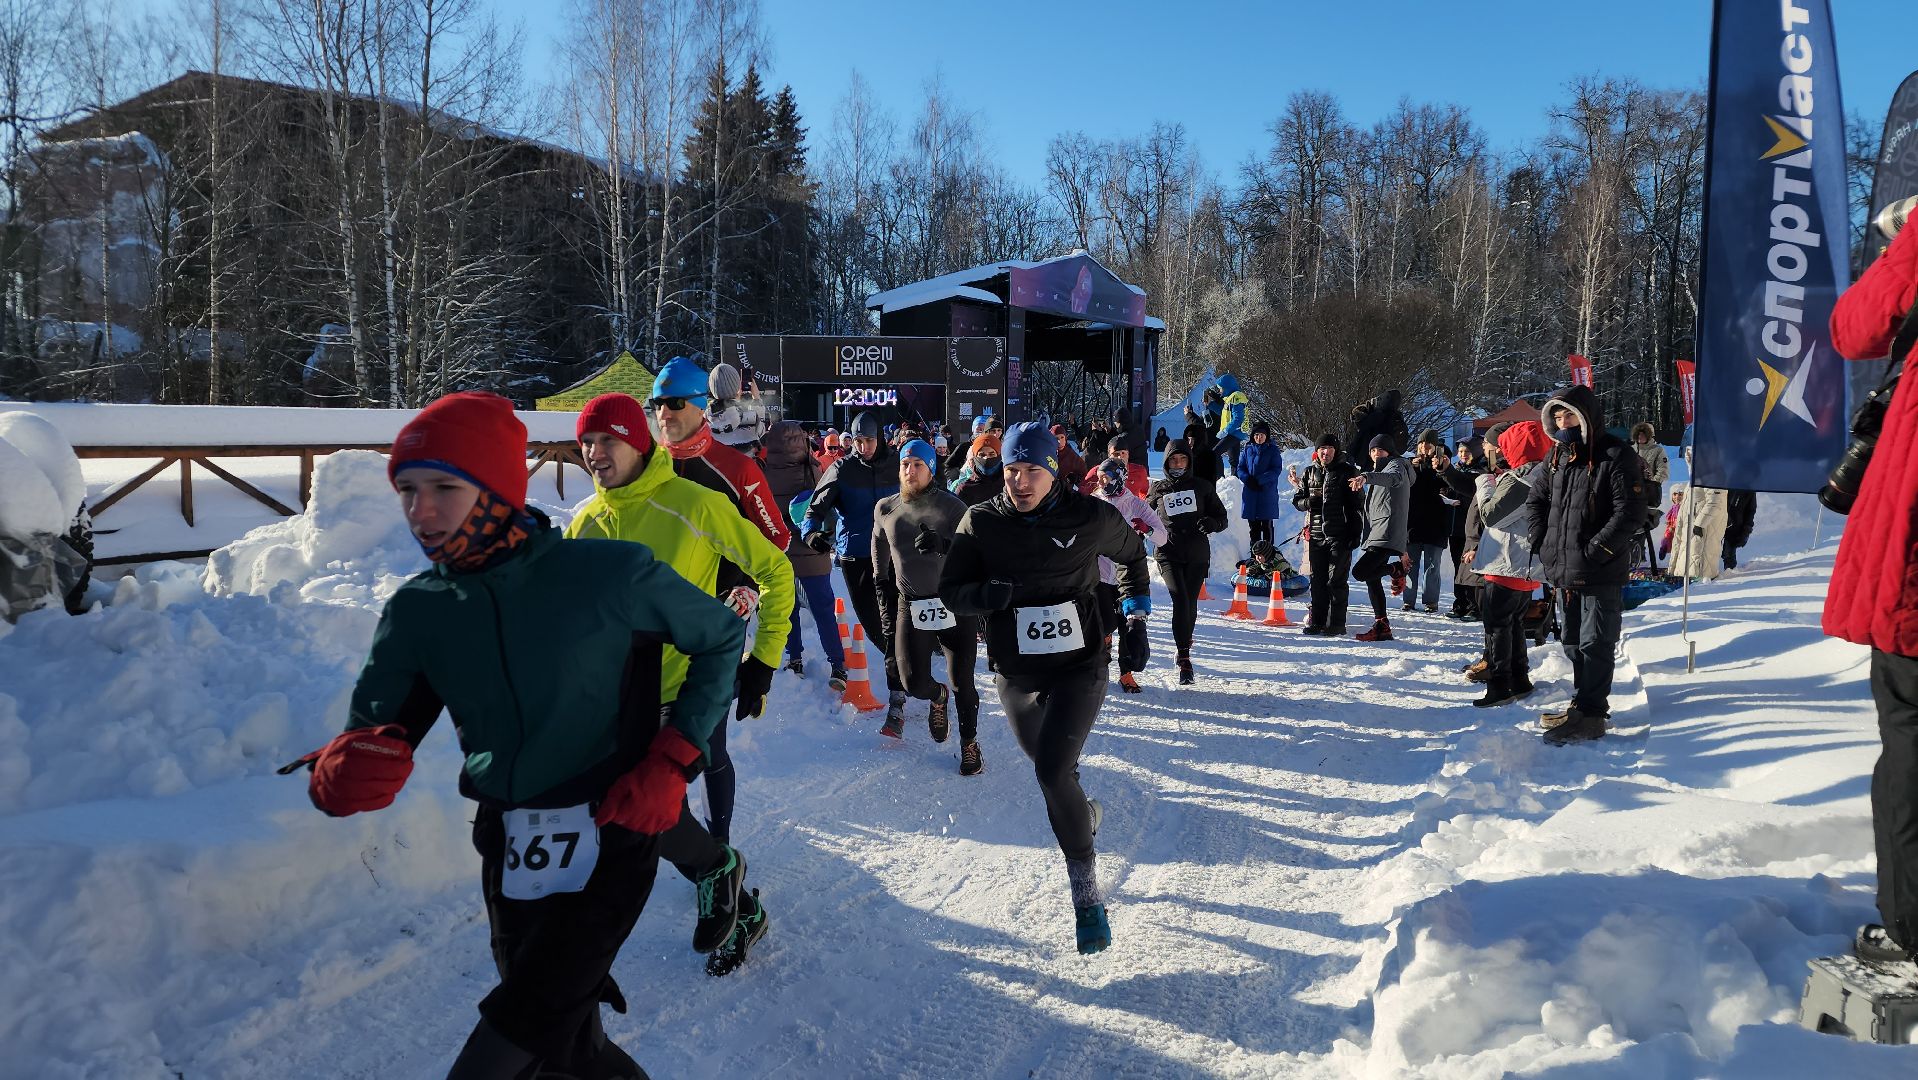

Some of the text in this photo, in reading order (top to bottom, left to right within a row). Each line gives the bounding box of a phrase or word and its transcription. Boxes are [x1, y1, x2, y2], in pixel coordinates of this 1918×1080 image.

[737, 343, 753, 369] RAILS
[841, 361, 888, 376] BAND
[833, 388, 898, 406] 12:30:04
[754, 494, 780, 536] ATOMIC
[918, 607, 948, 622] 673
[1026, 618, 1073, 640] 628
